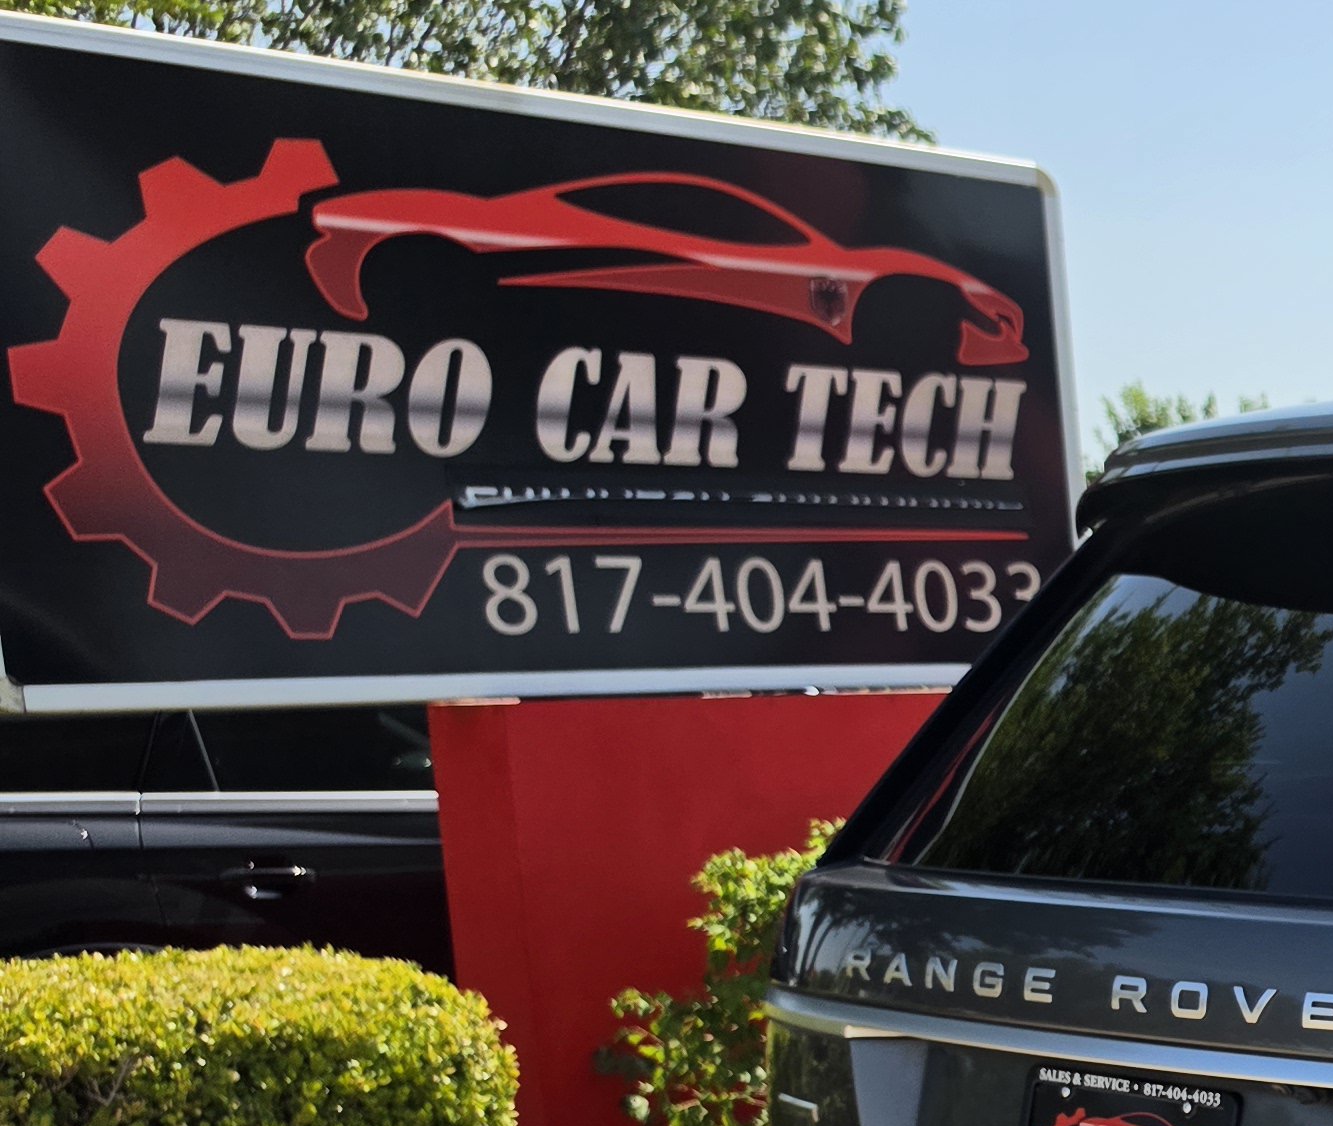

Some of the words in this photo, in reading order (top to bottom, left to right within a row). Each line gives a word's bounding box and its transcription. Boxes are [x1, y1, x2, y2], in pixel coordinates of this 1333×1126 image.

[142, 317, 494, 460] EURO
[535, 345, 748, 468] CAR
[786, 363, 1028, 480] TECH
[844, 947, 1057, 1004] RANGE
[1039, 1067, 1072, 1085] SALES
[1072, 1073, 1082, 1085] &
[1084, 1074, 1130, 1093] SERVICE
[1143, 1083, 1221, 1107] 817-404-4033
